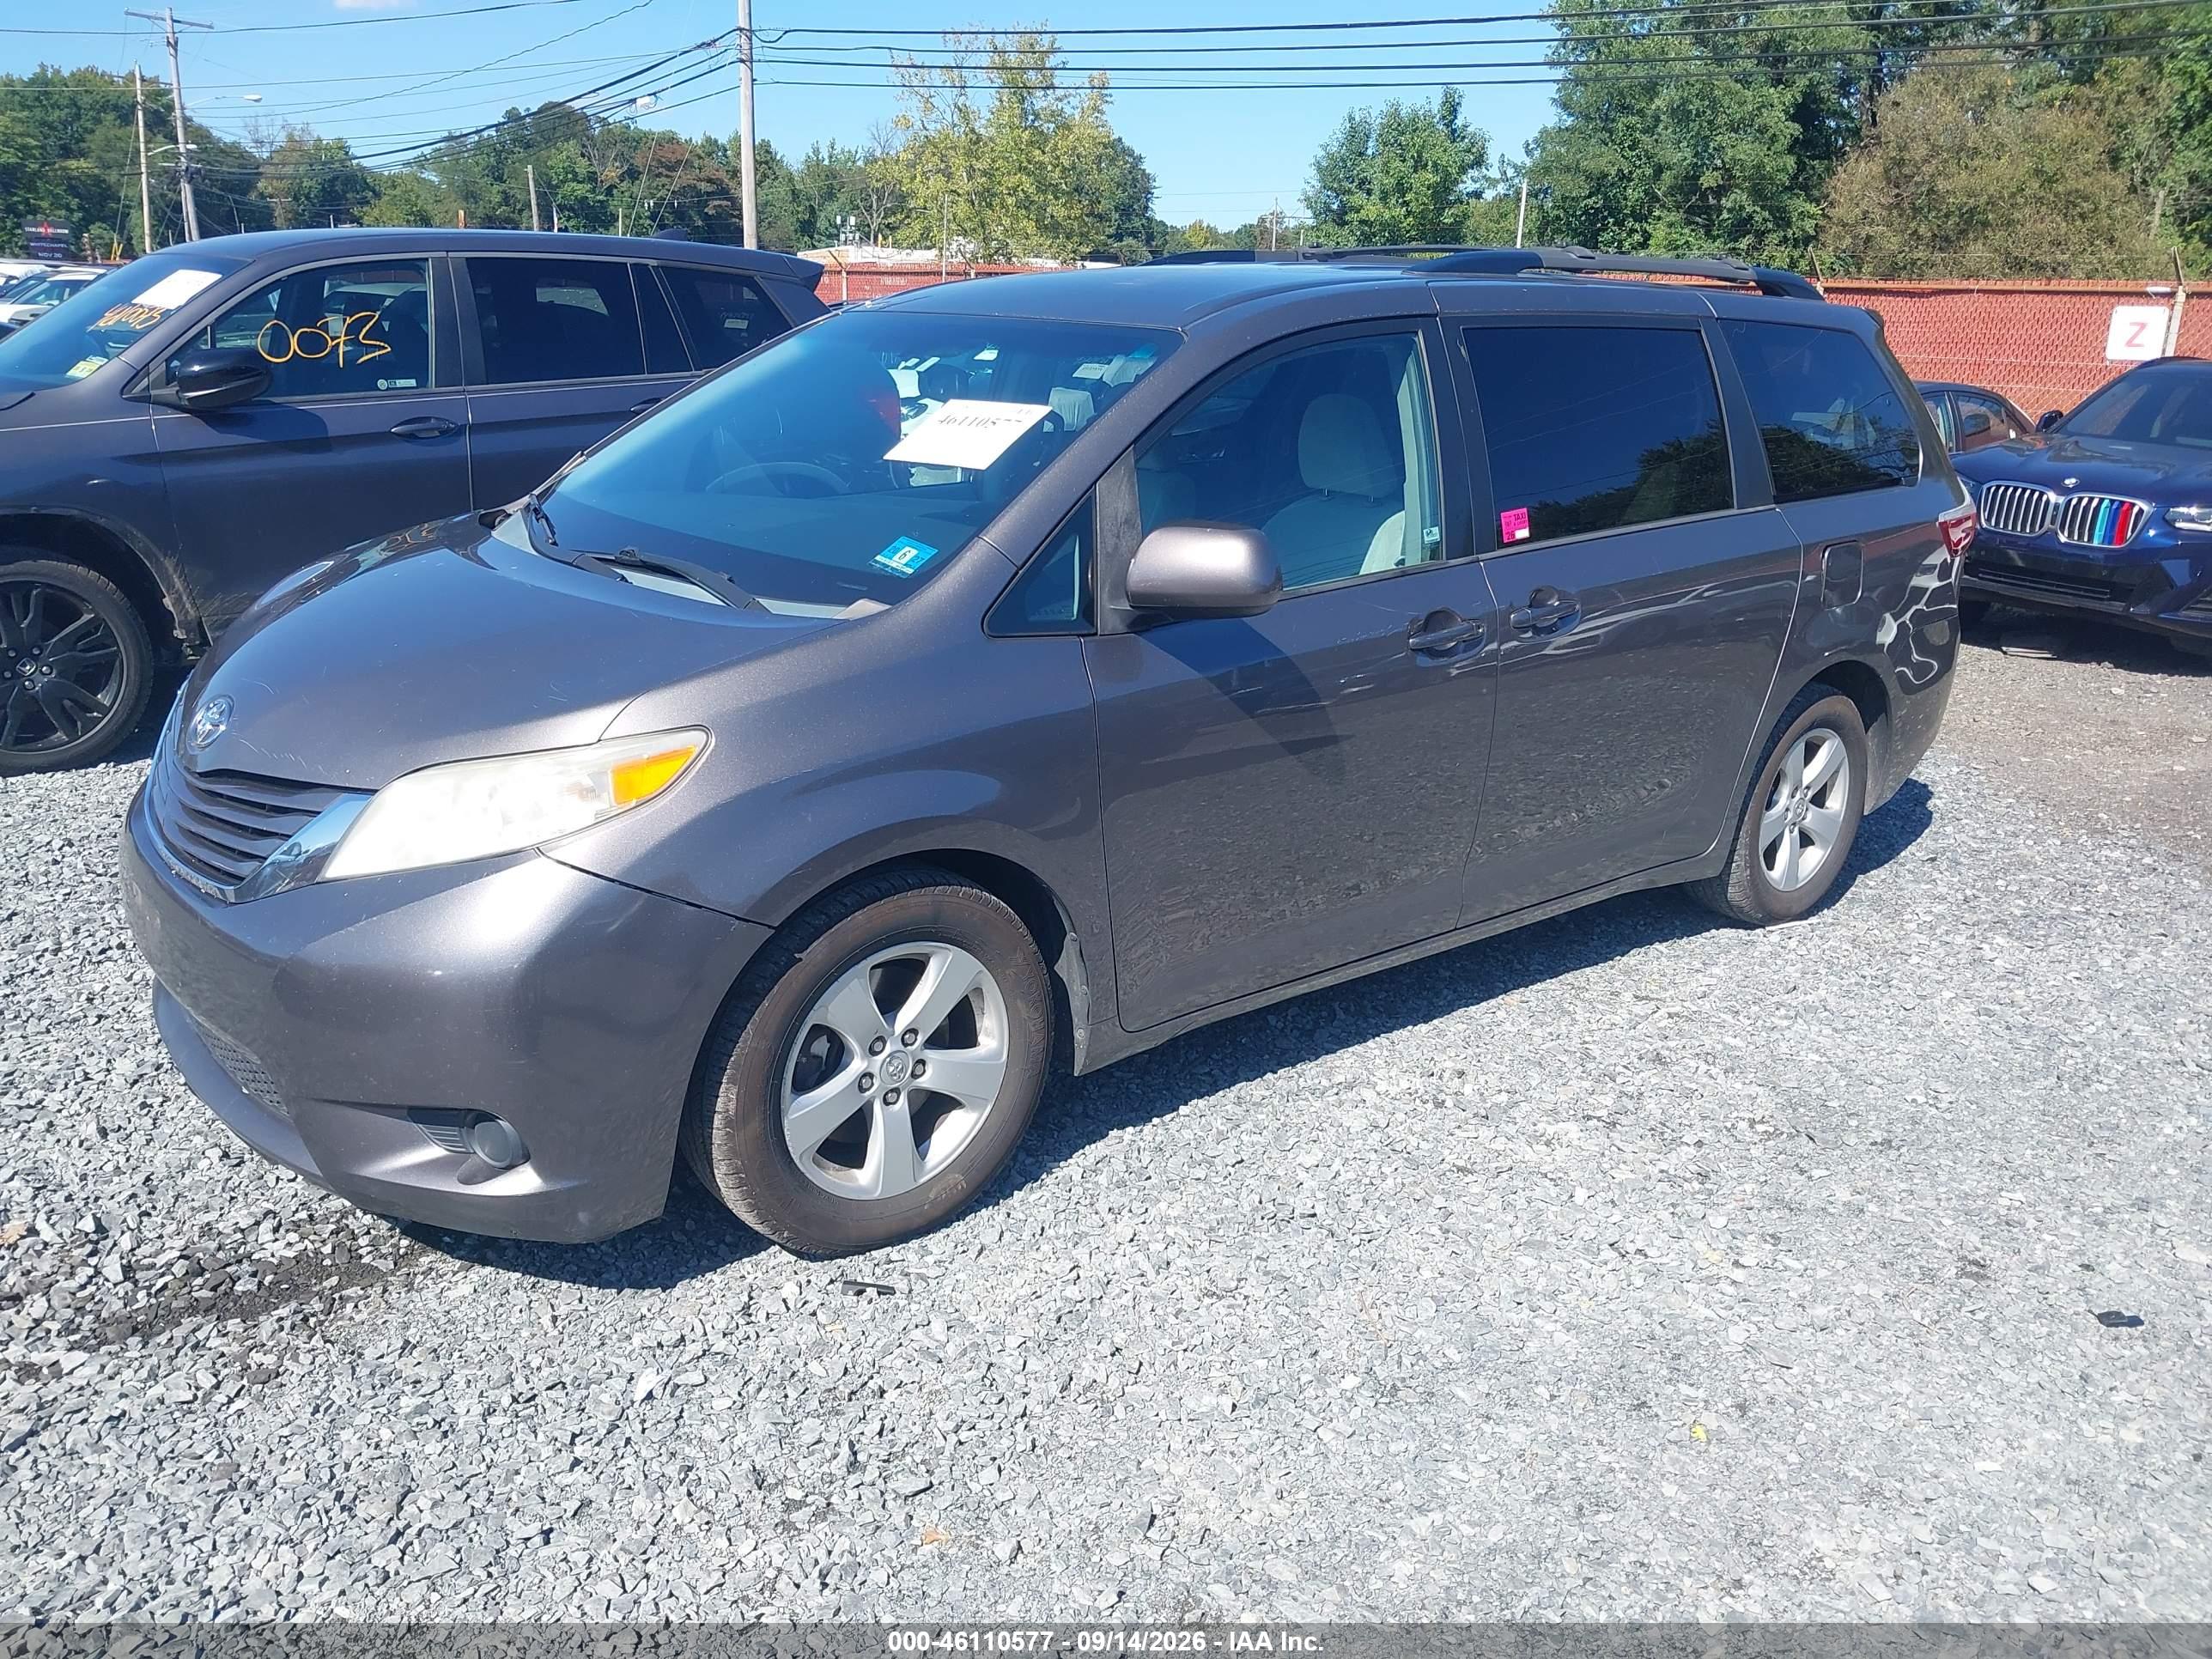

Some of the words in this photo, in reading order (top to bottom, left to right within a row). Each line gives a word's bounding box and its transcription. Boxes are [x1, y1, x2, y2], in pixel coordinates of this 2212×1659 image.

[257, 311, 392, 368] 0073
[2124, 321, 2149, 349] Z
[1513, 512, 1527, 521] TAXI
[1023, 966, 1045, 1080] YOKOHAMA
